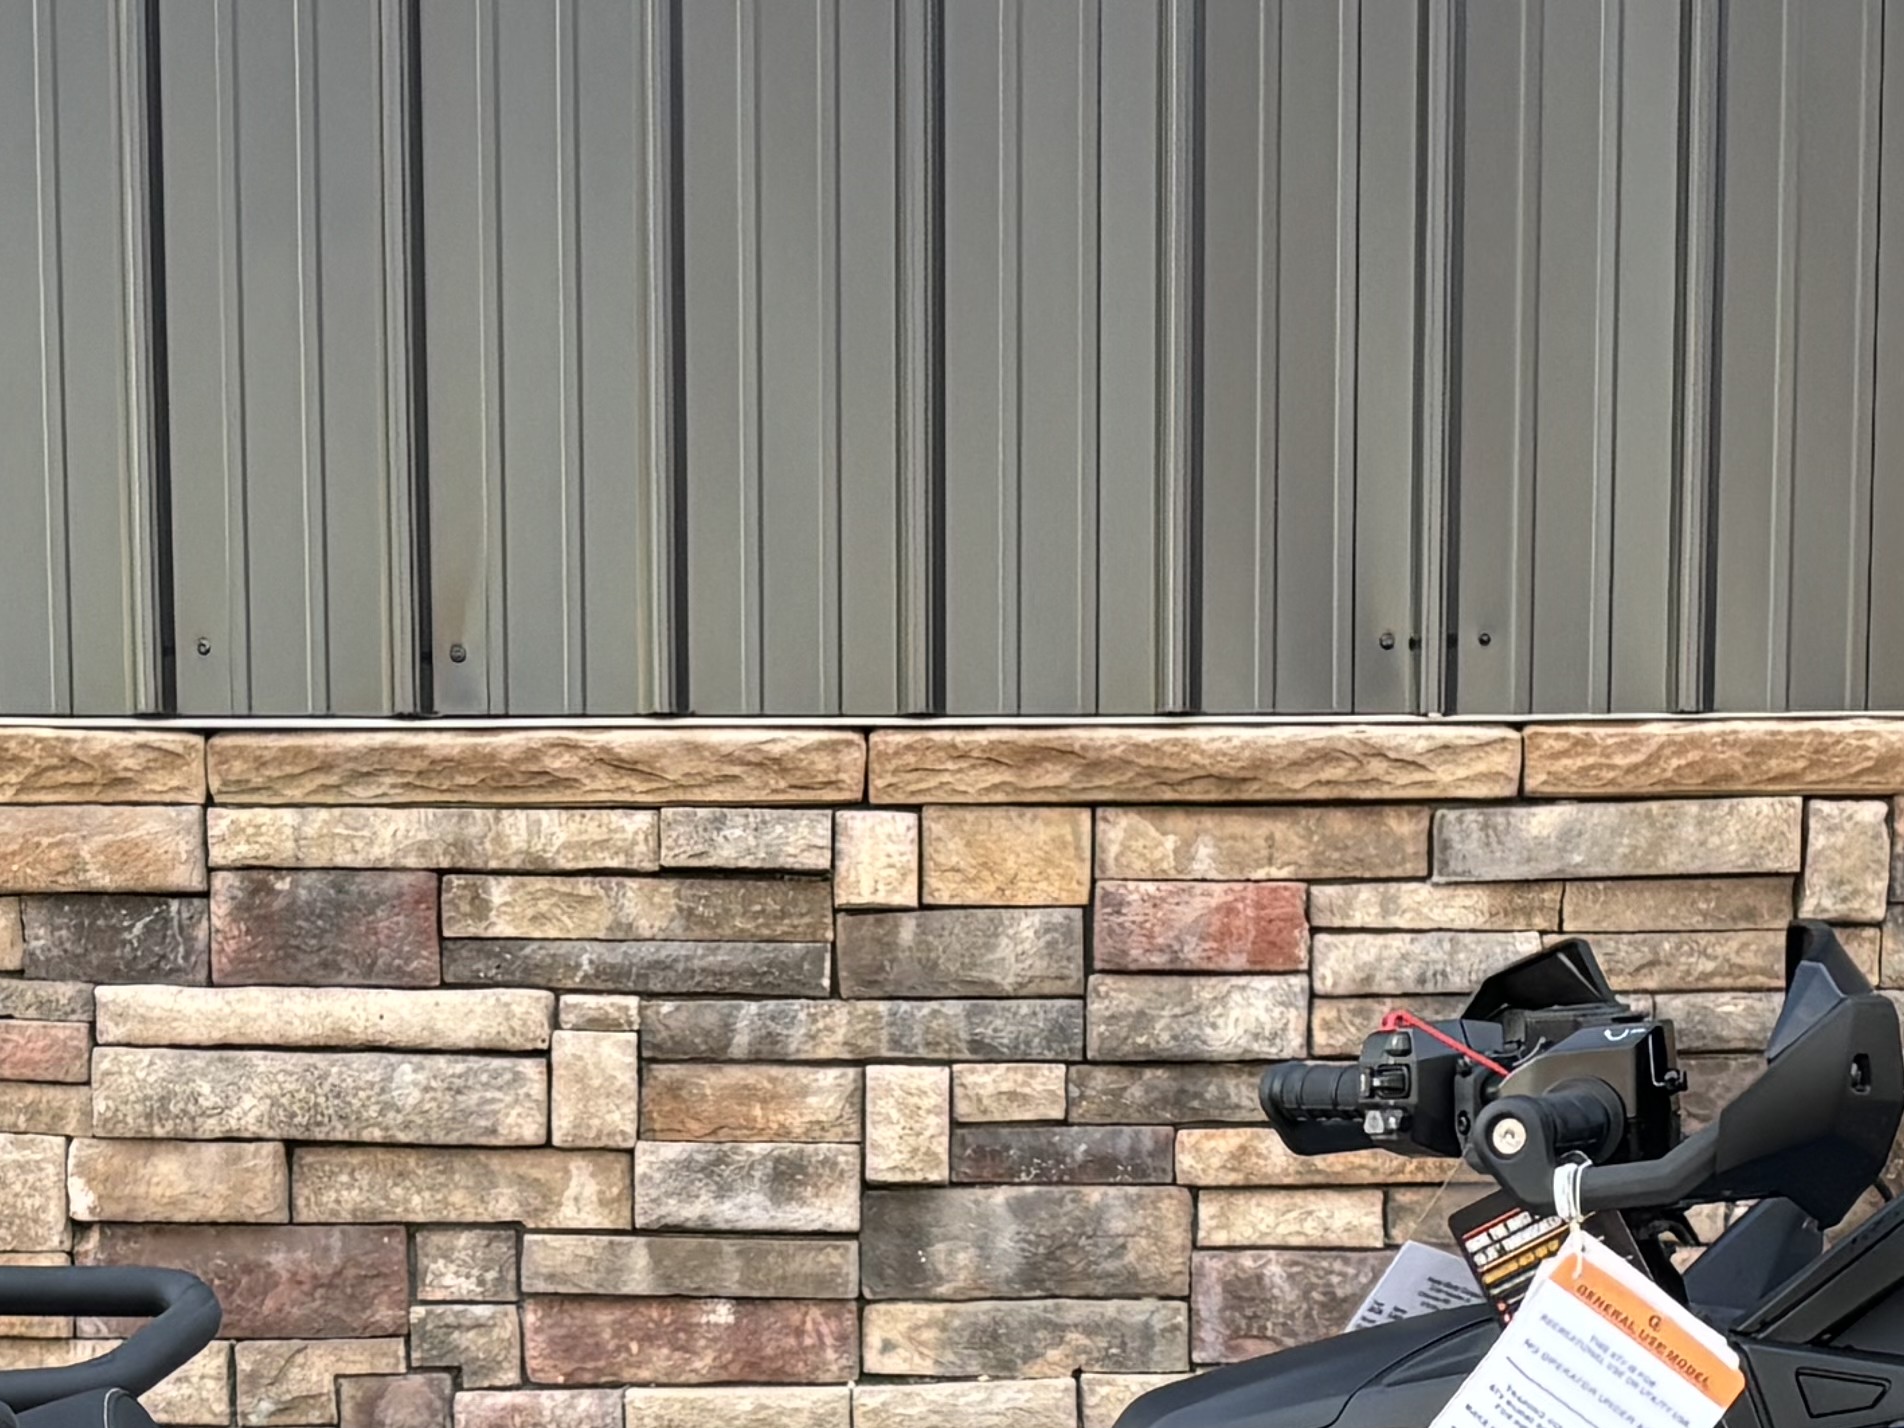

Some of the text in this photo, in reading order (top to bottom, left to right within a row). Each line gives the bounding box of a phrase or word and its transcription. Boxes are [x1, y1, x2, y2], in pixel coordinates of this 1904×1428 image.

[1574, 1282, 1715, 1390] GENERAL USE MODEL
